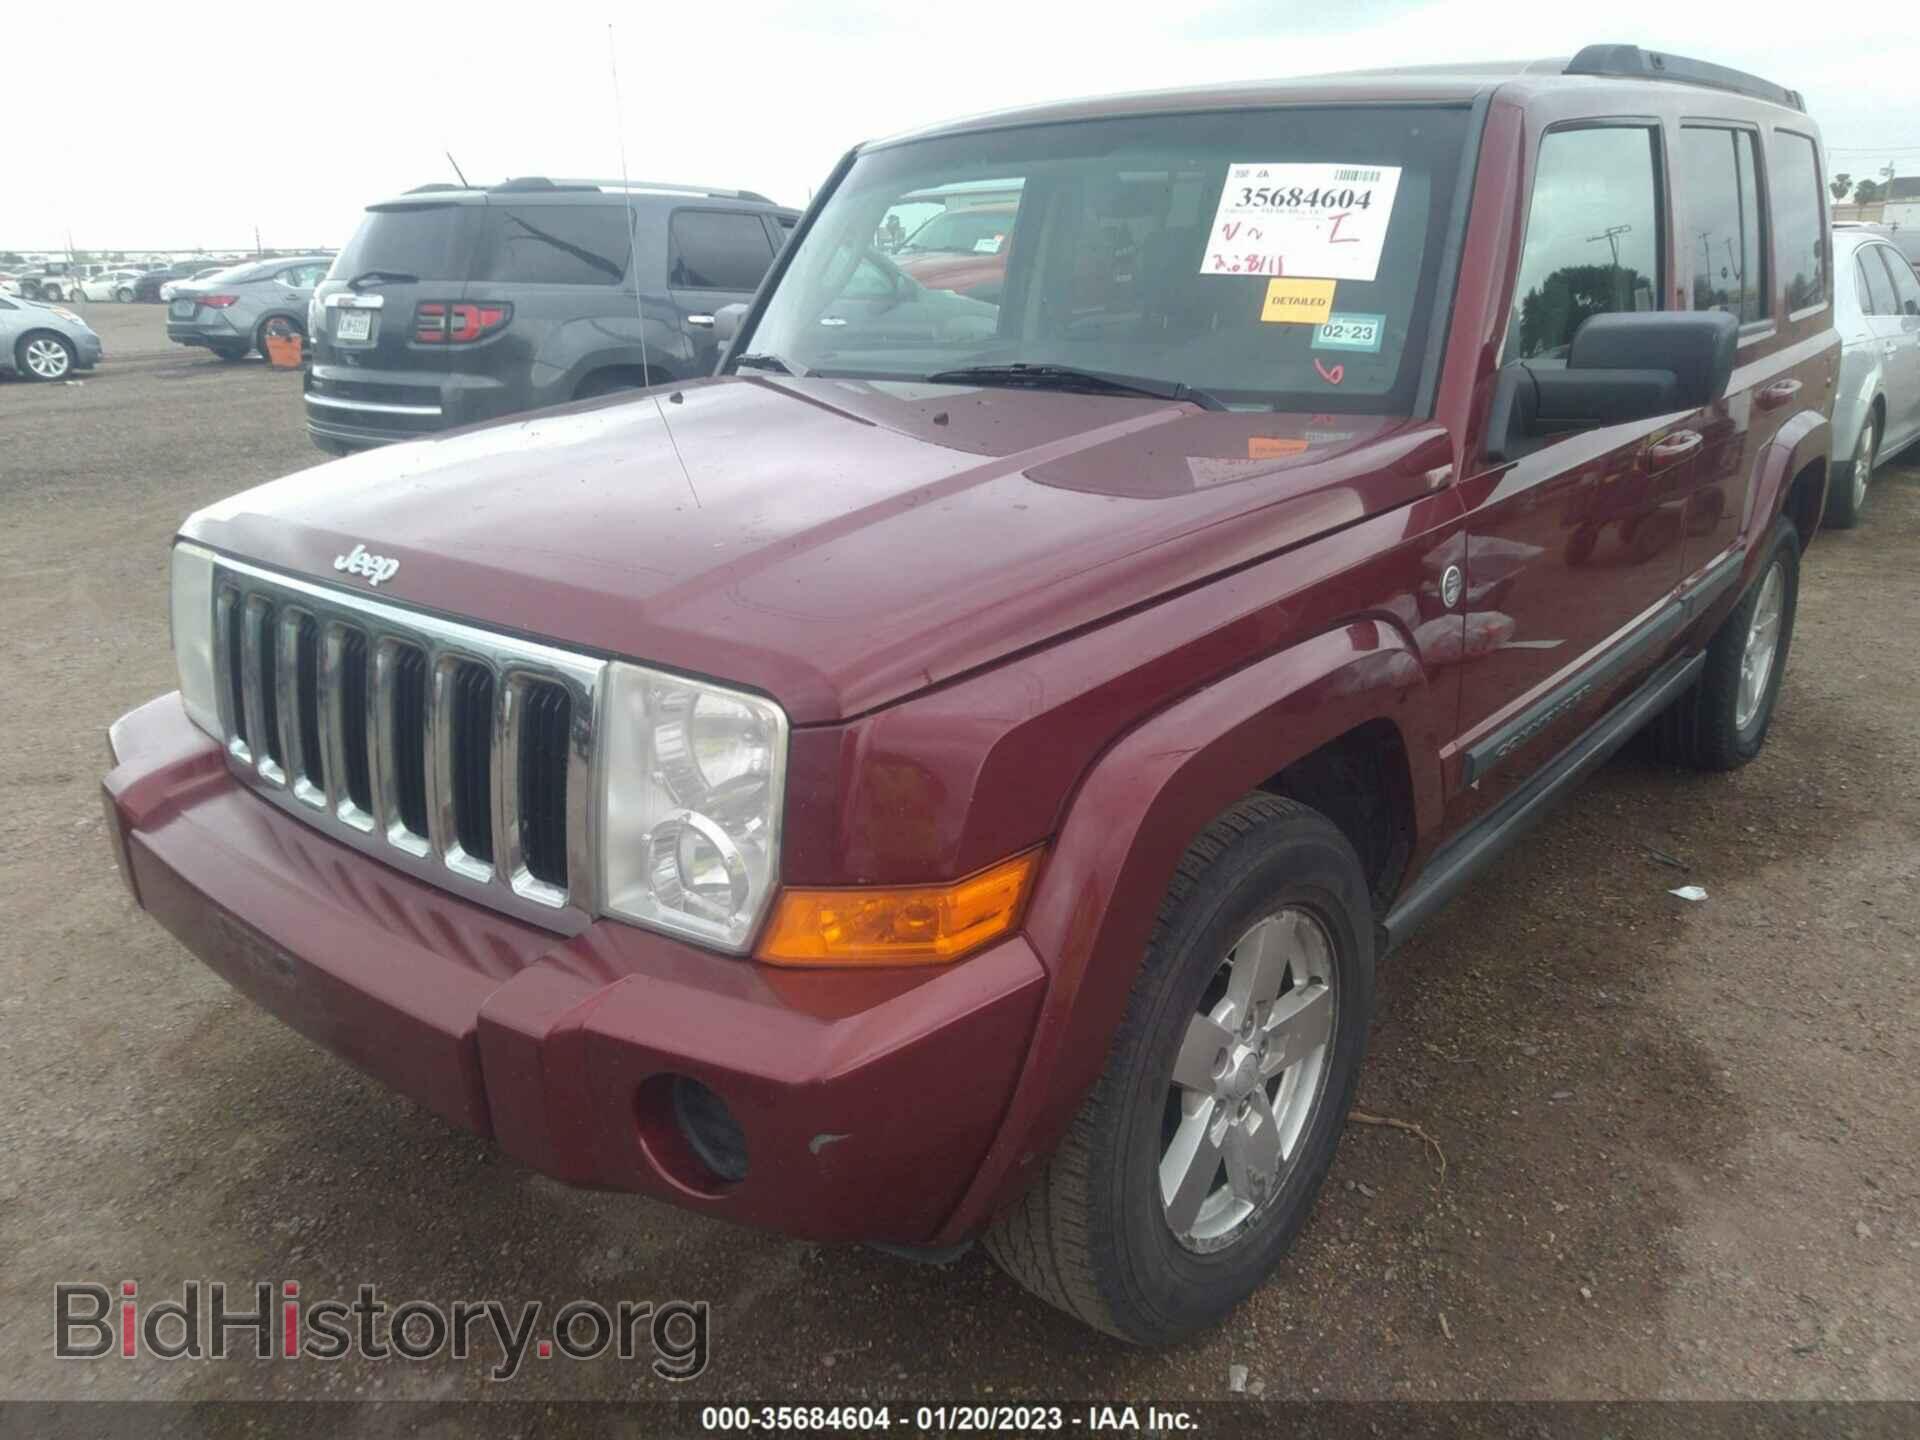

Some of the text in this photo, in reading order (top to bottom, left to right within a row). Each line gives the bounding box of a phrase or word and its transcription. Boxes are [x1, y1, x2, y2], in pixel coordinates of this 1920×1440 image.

[1235, 187, 1372, 210] 35684604
[1272, 296, 1326, 306] DETAILED
[334, 543, 400, 587] Jeep
